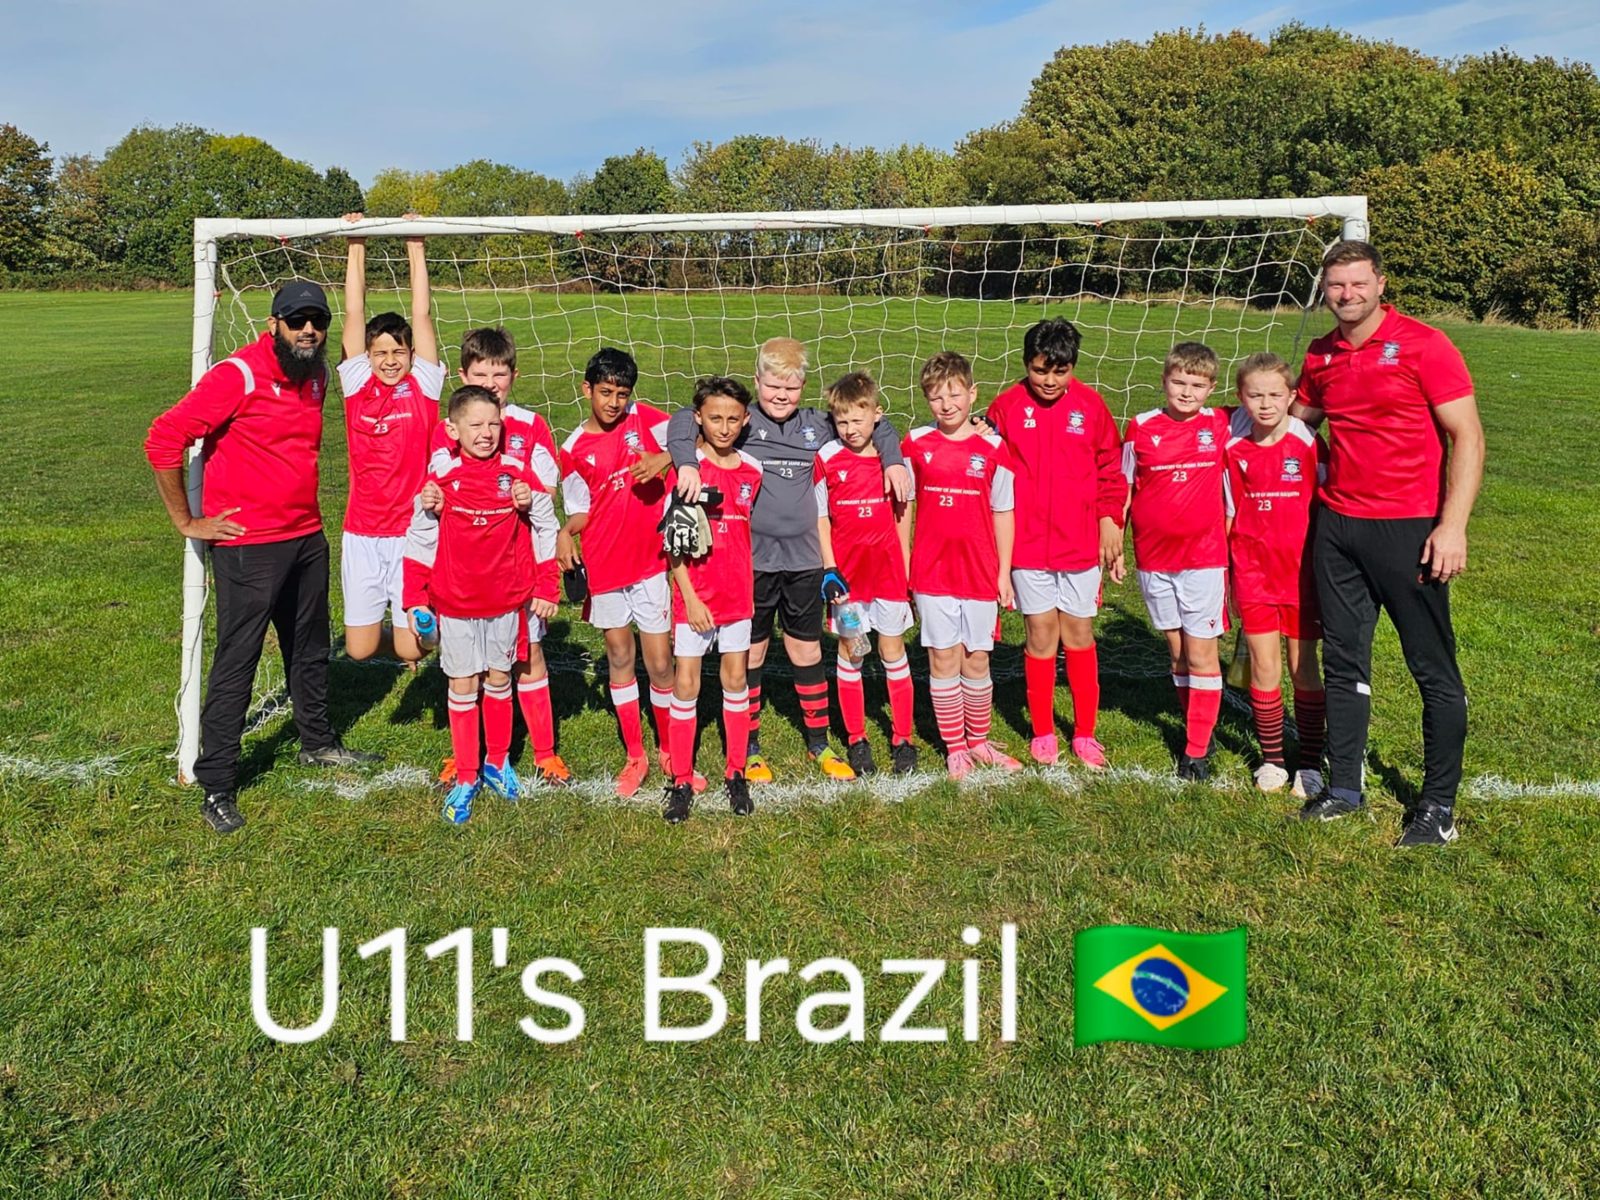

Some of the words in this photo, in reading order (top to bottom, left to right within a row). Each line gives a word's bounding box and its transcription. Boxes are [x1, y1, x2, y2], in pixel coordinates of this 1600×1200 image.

[374, 423, 388, 434] 23
[780, 467, 793, 478] 23
[1172, 471, 1187, 482] 23
[612, 477, 625, 492] 23
[939, 495, 953, 507] 23
[1258, 499, 1272, 511] 23
[858, 506, 873, 518] 23
